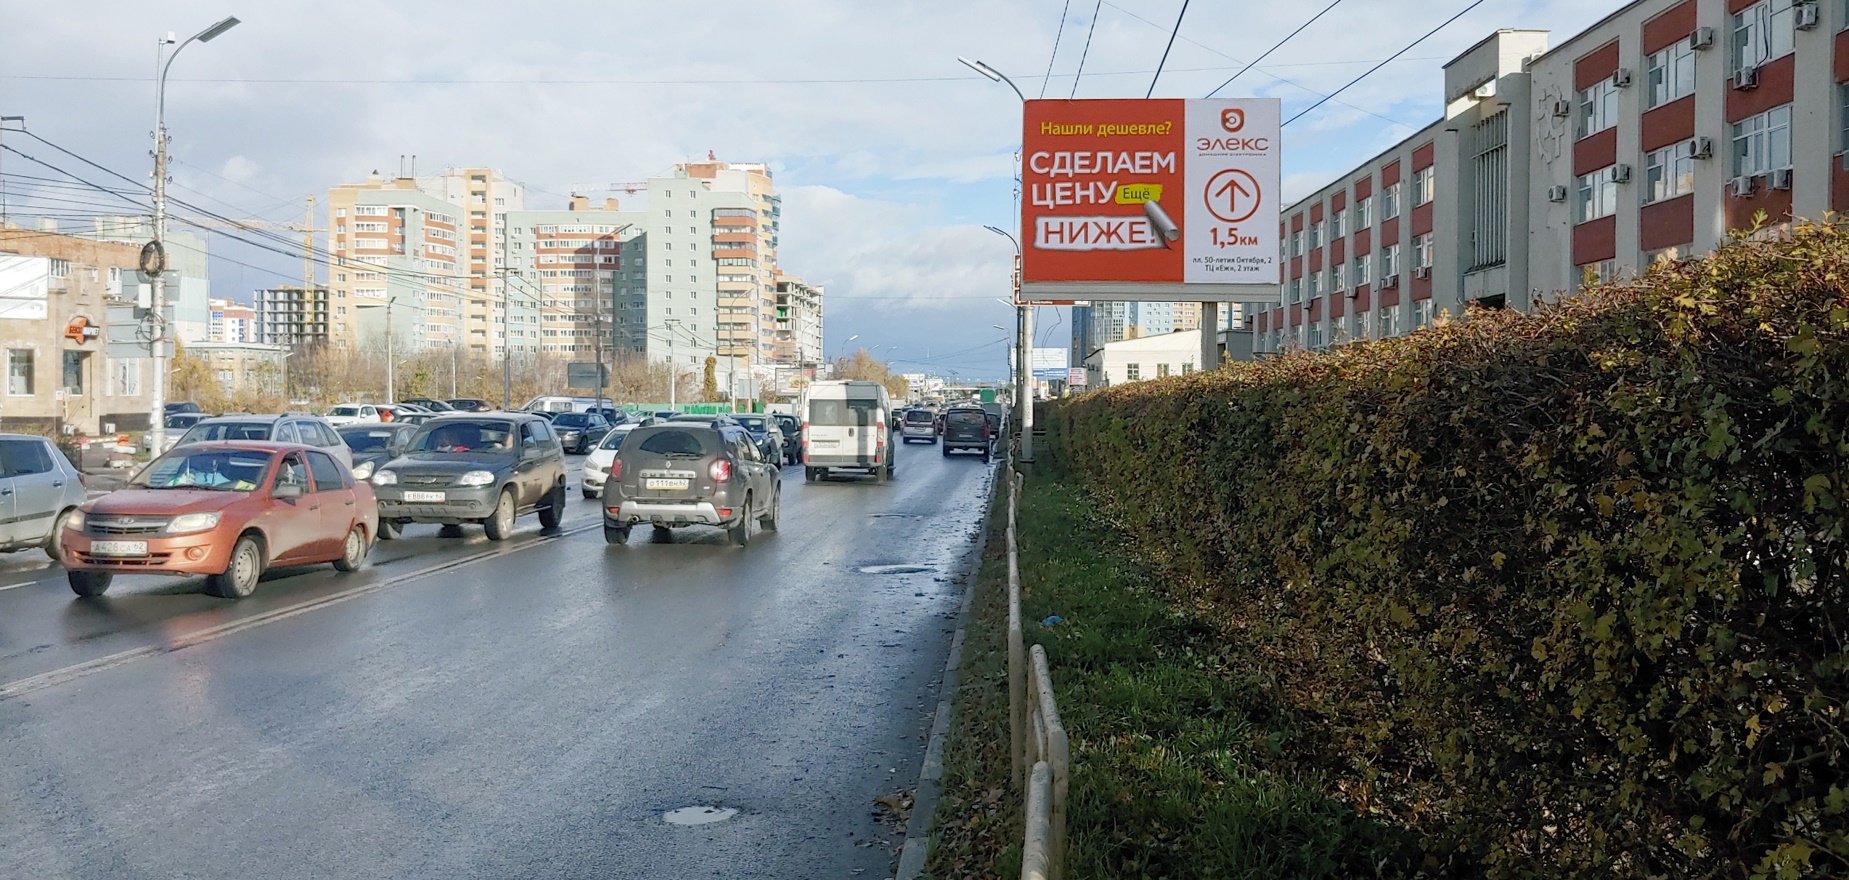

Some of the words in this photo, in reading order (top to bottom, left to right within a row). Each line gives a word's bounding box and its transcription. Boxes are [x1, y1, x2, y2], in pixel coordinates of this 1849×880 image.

[1040, 121, 1093, 135] Нашли
[1096, 120, 1173, 137] дешевле?
[1029, 151, 1175, 178] СДЕЛАЕМ
[1031, 181, 1118, 210] ЦЕНУ
[1122, 188, 1151, 200] Ещё
[1043, 221, 1156, 244] НИЖЕ!
[1204, 256, 1235, 264] 50-летия
[1236, 256, 1267, 265] Октября,
[1204, 265, 1215, 273] ТЦ
